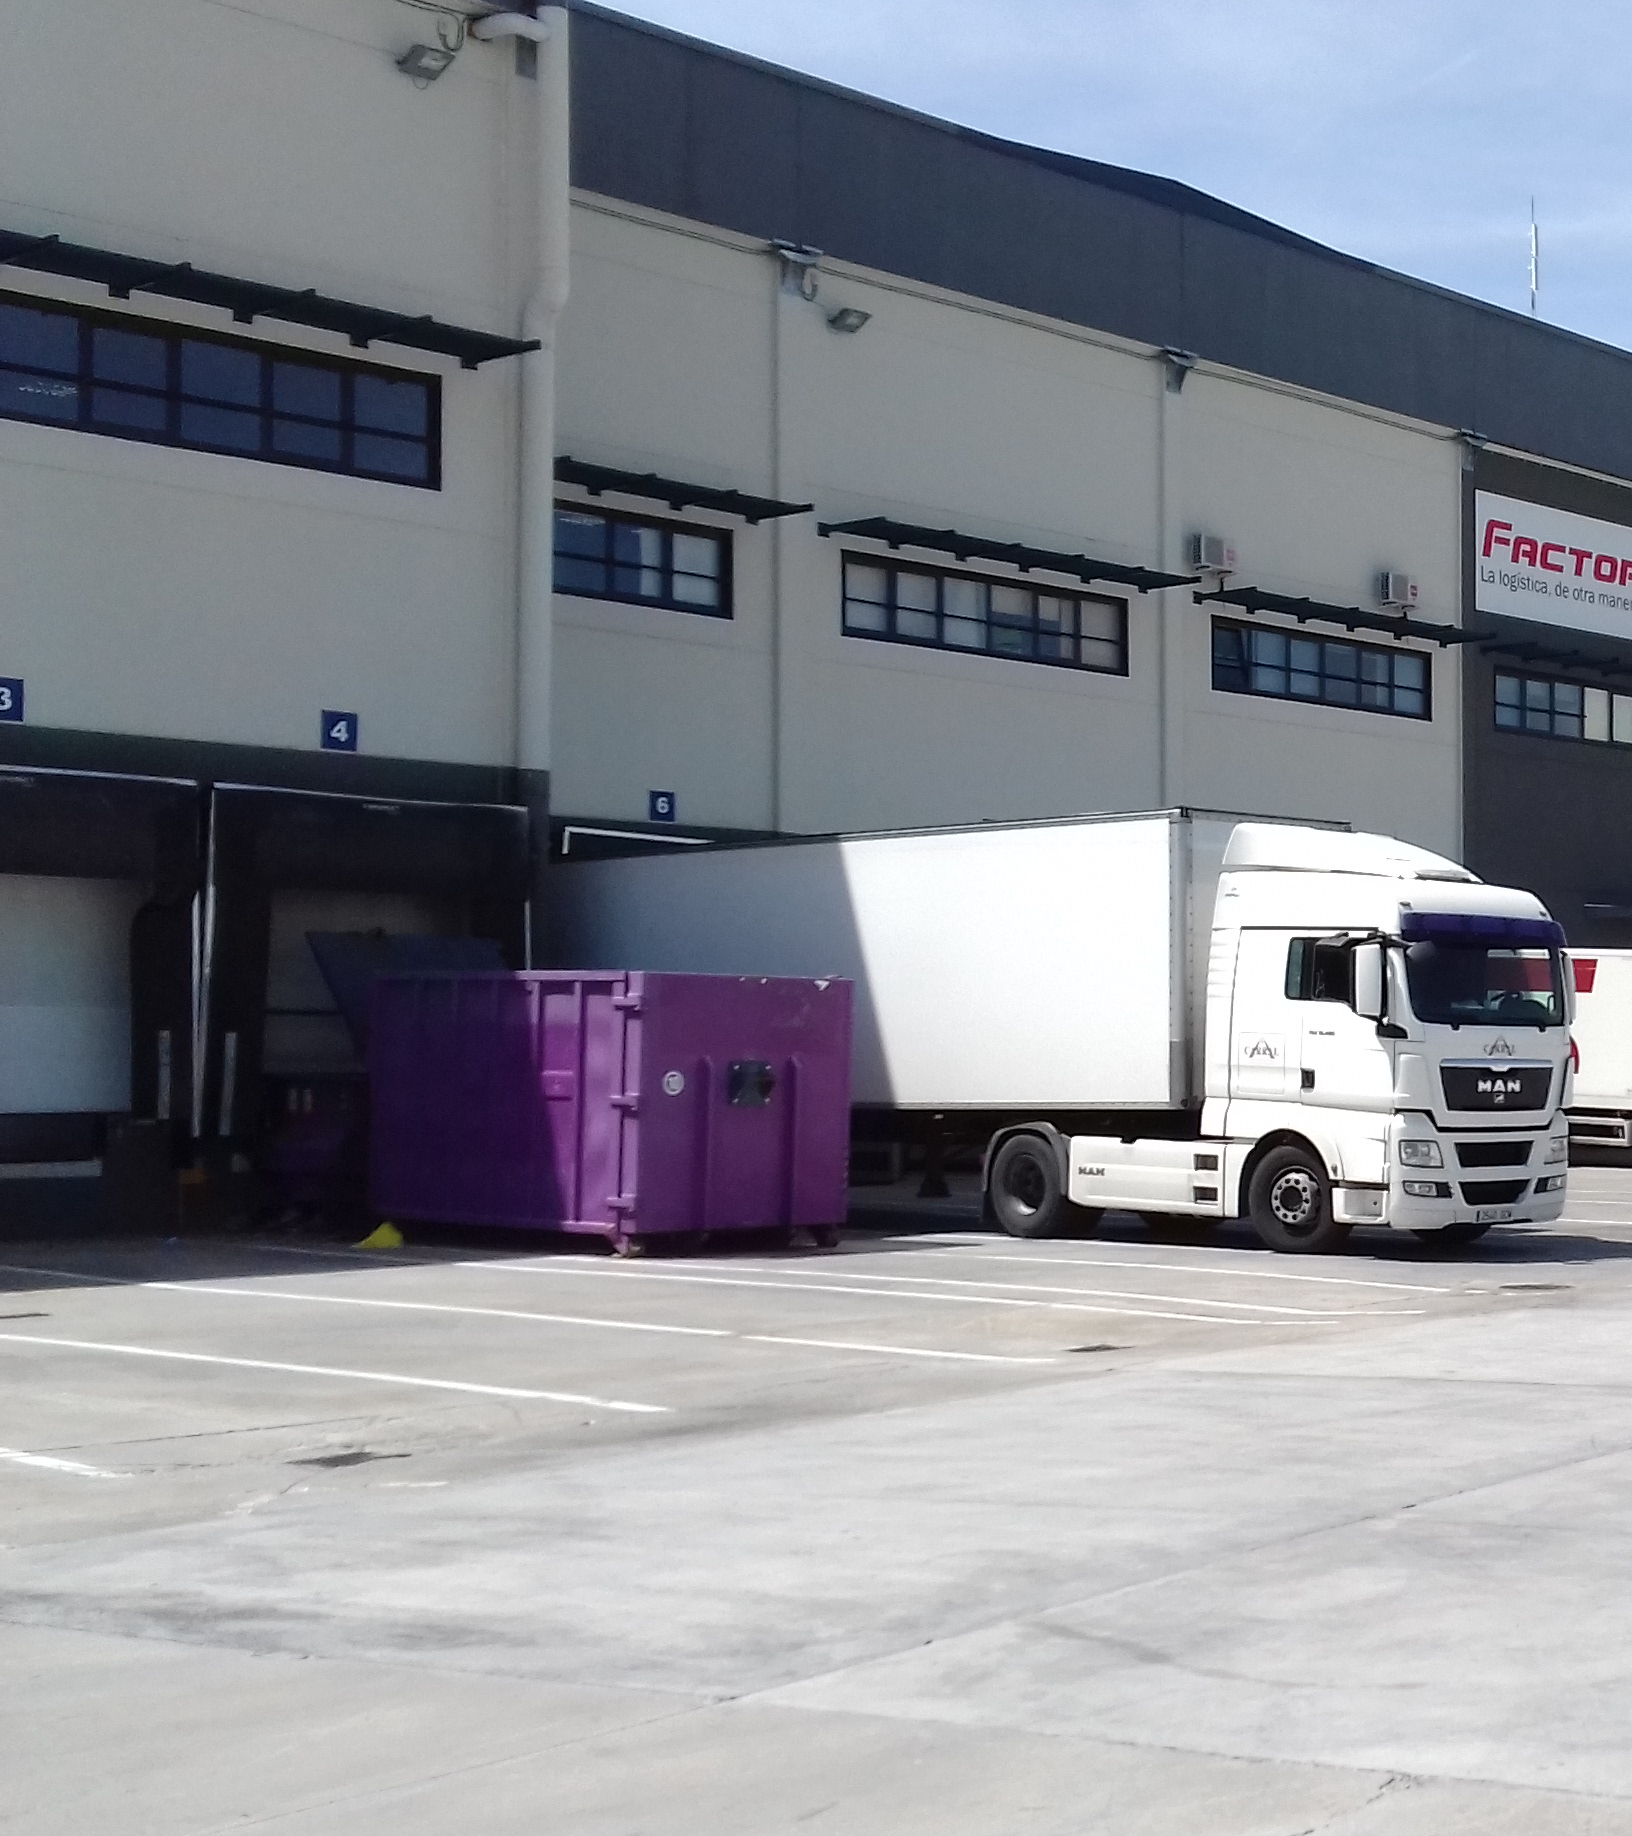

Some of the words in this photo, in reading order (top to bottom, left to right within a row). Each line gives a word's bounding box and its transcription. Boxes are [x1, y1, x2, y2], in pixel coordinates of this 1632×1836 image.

[1481, 565, 1495, 584] La
[1499, 569, 1551, 597] logística,
[1555, 581, 1569, 599] de
[1572, 587, 1595, 604] otra
[0, 686, 12, 710] 3
[330, 720, 348, 742] 4
[656, 796, 669, 814] 6
[1477, 1079, 1521, 1093] MAN
